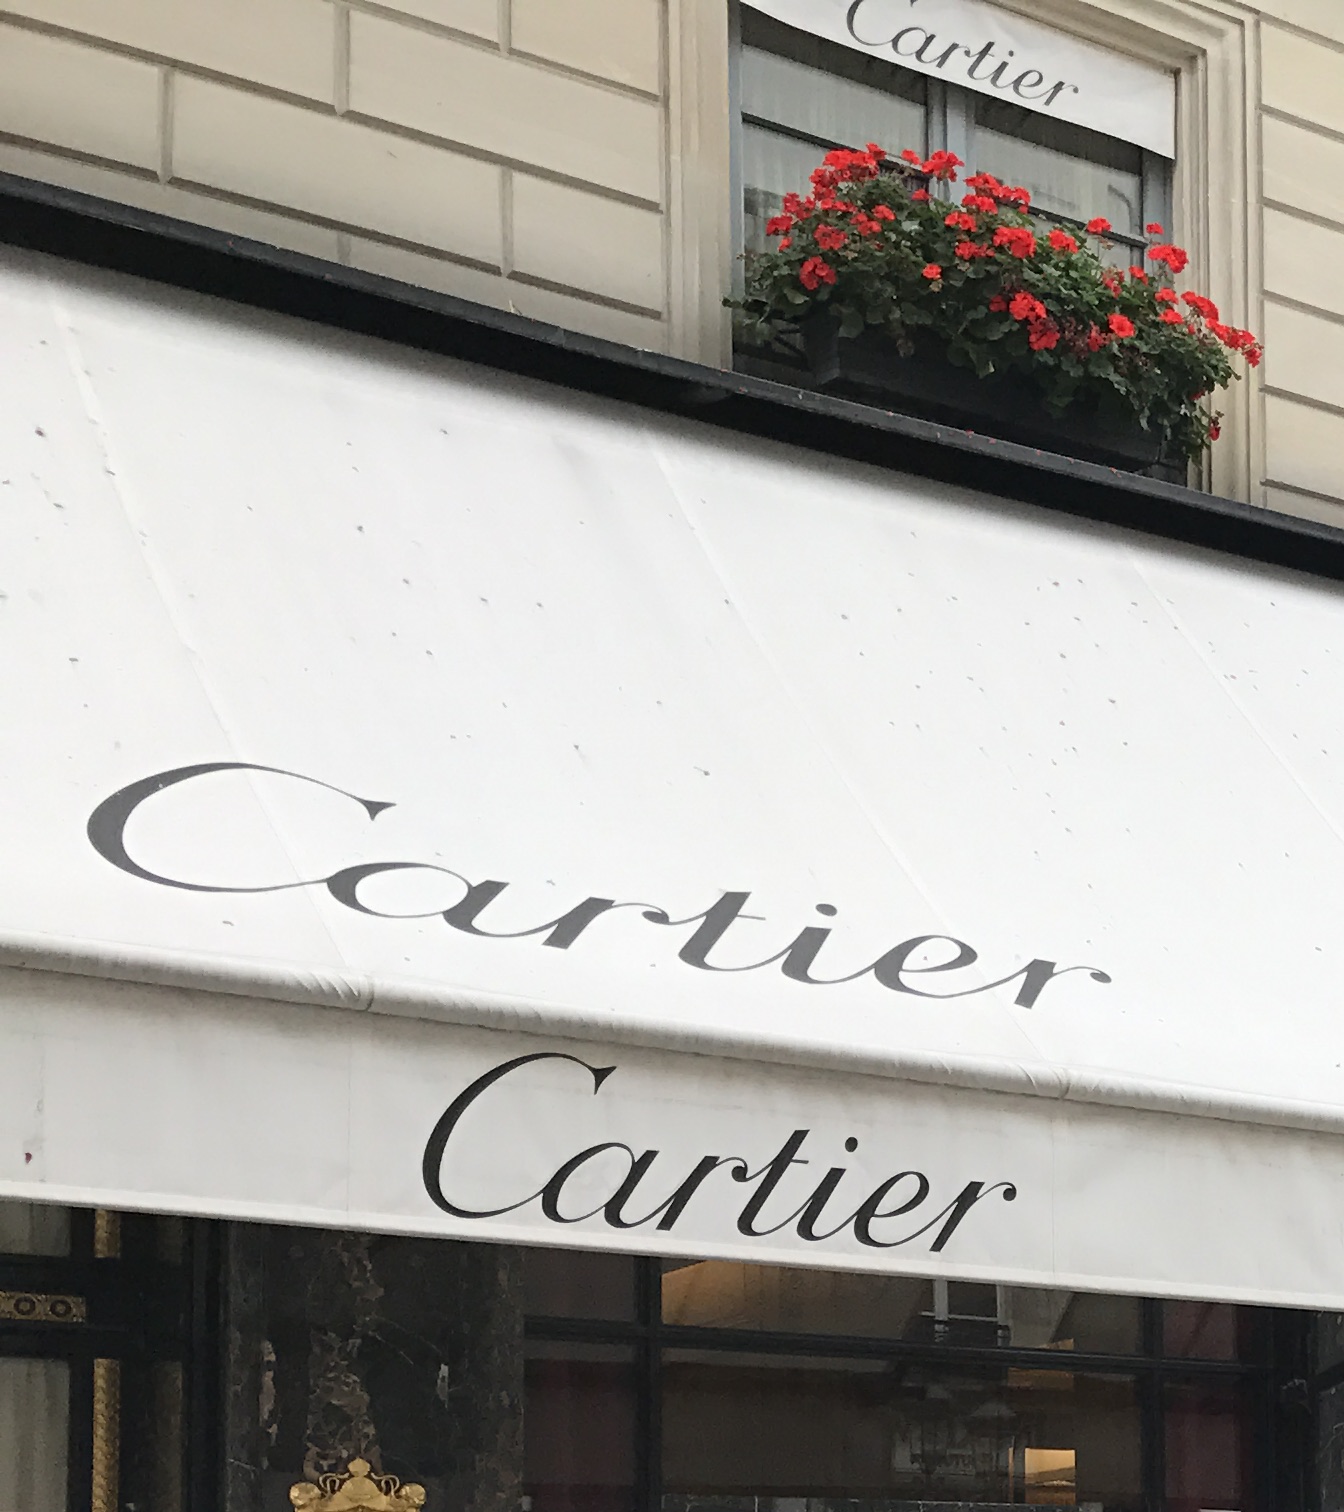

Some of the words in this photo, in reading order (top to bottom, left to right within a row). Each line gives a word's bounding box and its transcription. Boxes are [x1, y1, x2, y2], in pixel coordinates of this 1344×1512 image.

[845, 0, 1079, 107] Cartier
[86, 761, 1112, 1009] Cartier
[421, 1052, 1017, 1252] Cartier
